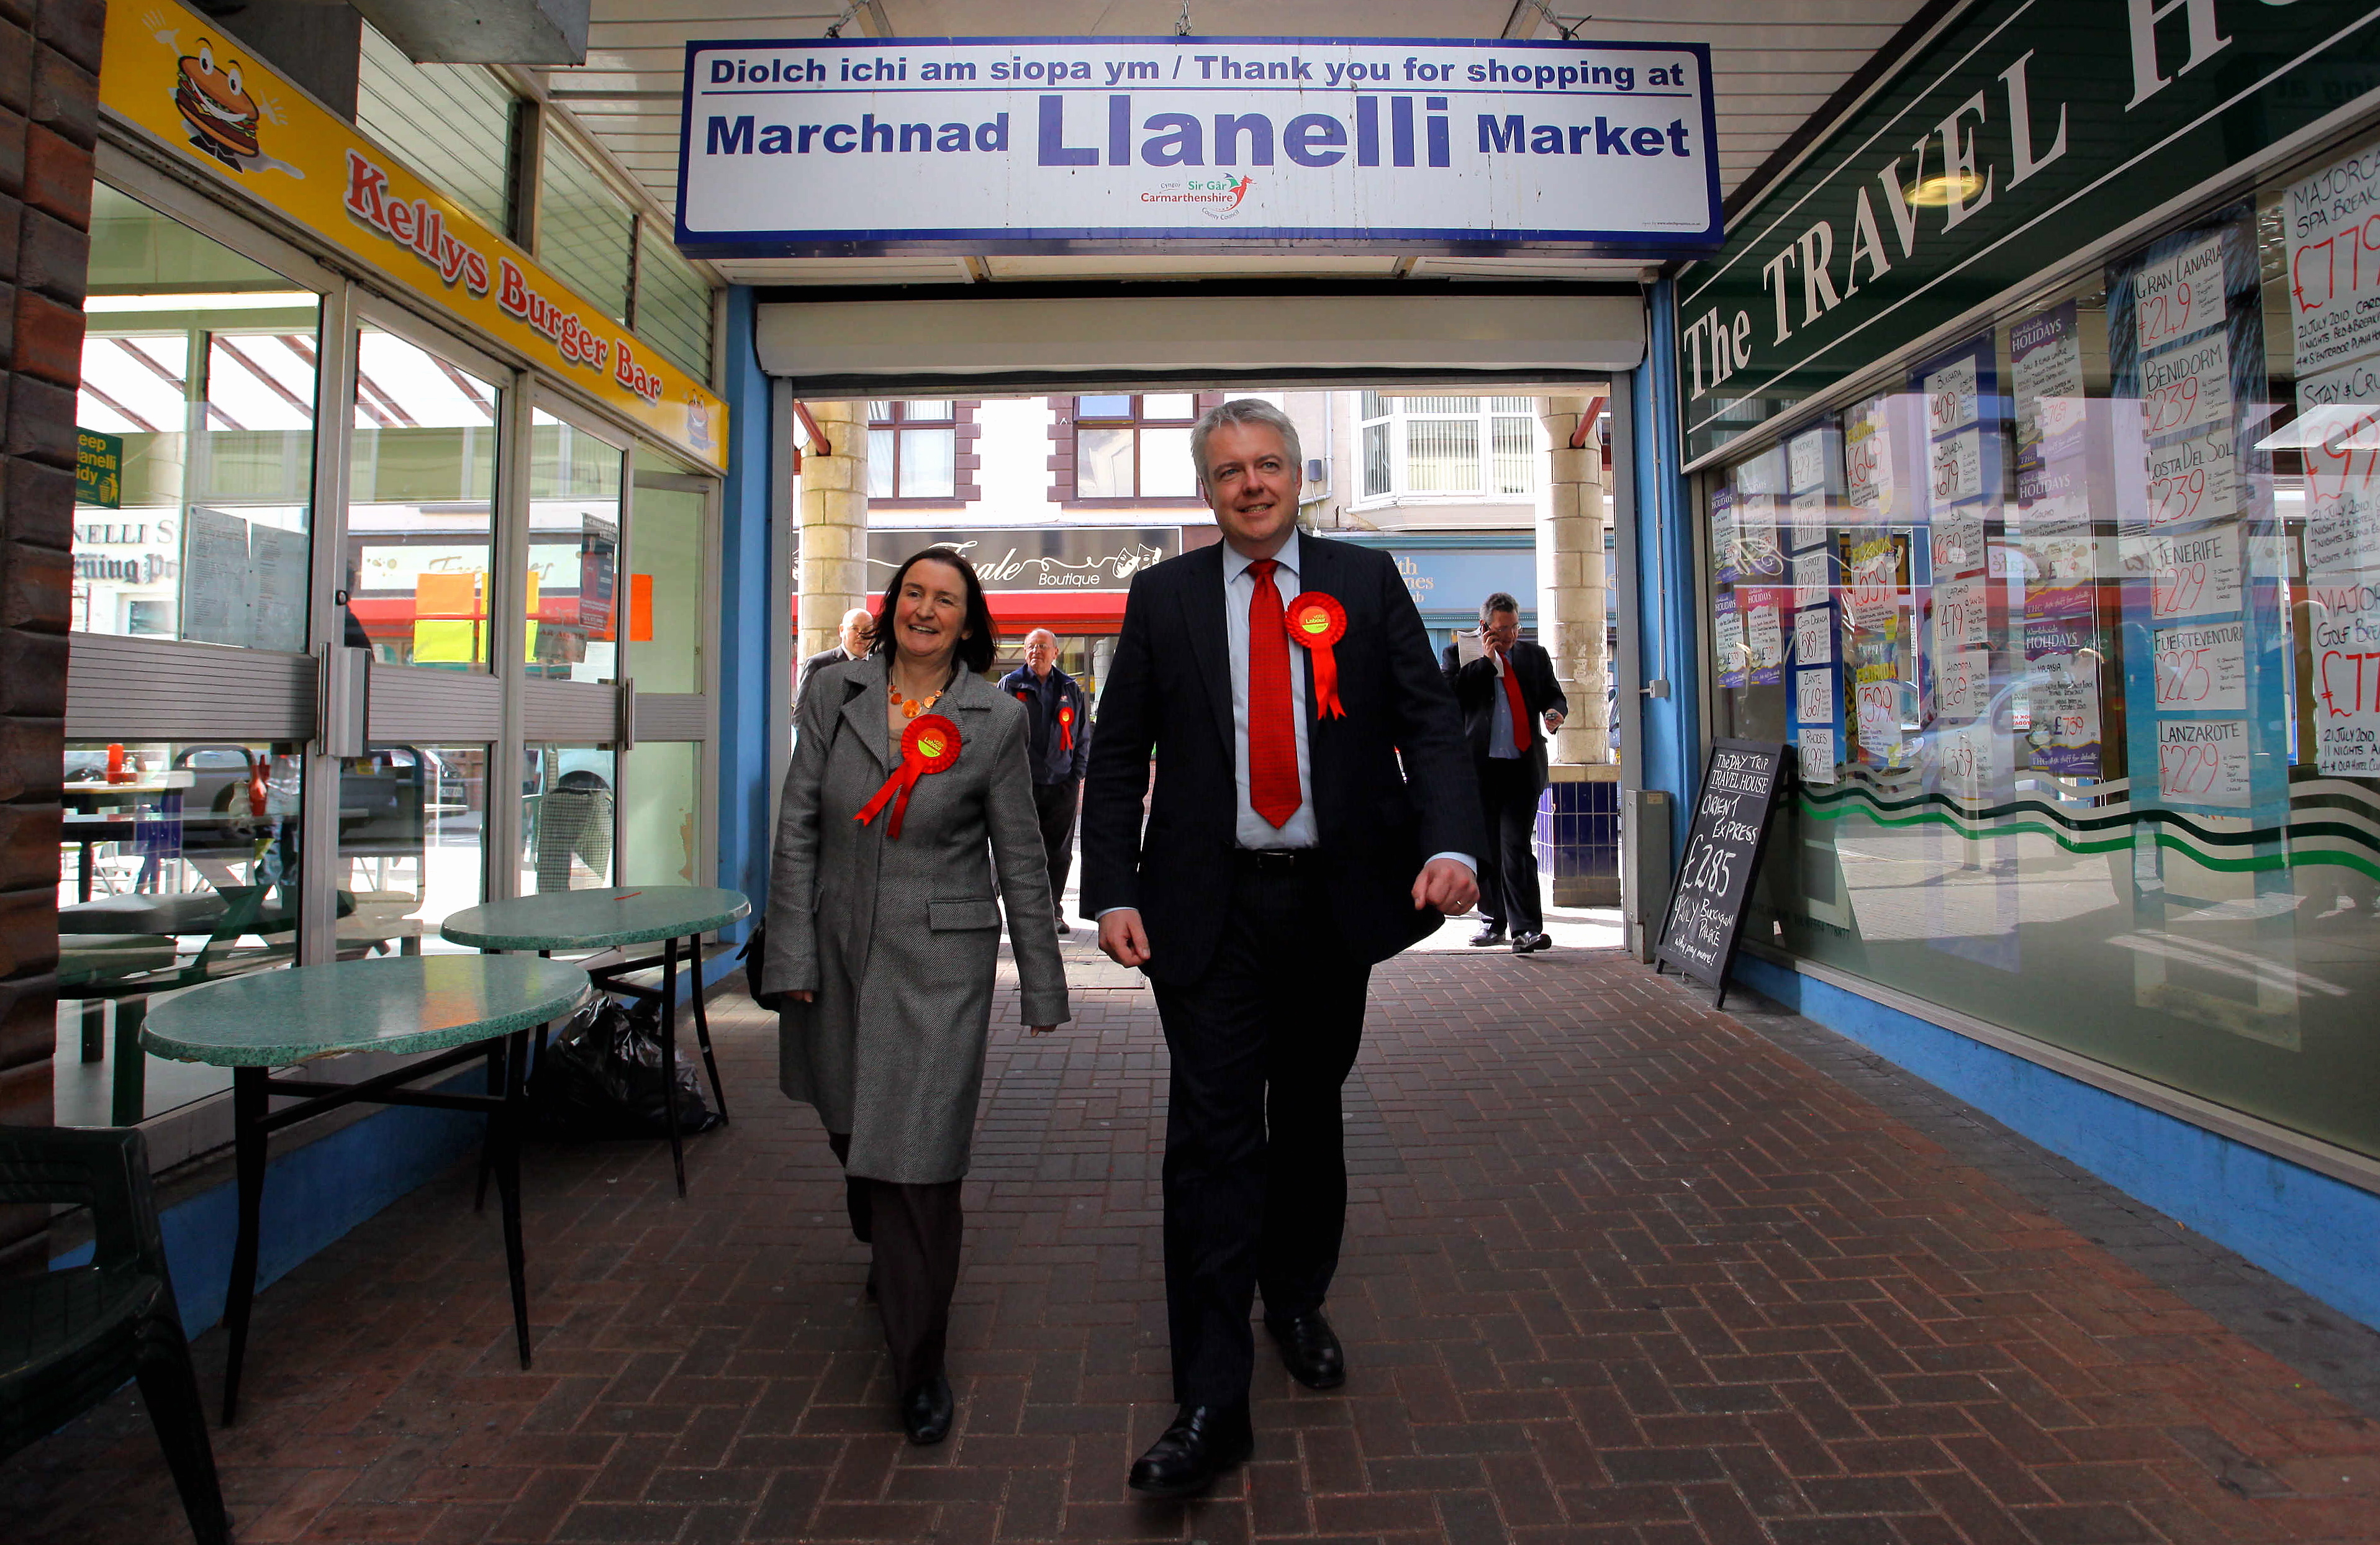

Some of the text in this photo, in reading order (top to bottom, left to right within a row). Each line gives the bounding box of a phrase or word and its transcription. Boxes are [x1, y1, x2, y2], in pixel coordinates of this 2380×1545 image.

[711, 55, 1684, 91] Diolch ichi am siopa ym / Thank you for shopping at
[707, 95, 1690, 167] Marchnad Llanelli Market
[1141, 193, 1233, 202] Carmarthenshire
[1188, 181, 1203, 190] Sir
[1207, 181, 1227, 190] Gâr
[1202, 207, 1239, 220] County Council
[1683, 48, 2066, 402] The TRAVEL
[2296, 209, 2328, 239] SPA
[346, 151, 663, 402] Kellys Burger Bar
[2135, 245, 2223, 300] GRAN CANARIA
[2138, 283, 2191, 347] £249
[2012, 319, 2061, 353] HOLIDAYS
[2145, 344, 2223, 392] BENIDORM
[2145, 376, 2198, 437] £239
[2304, 379, 2340, 410] STAY
[78, 433, 106, 452] eep
[2145, 432, 2234, 481] COSTA DEL SOL
[77, 446, 117, 470] lanelli
[76, 464, 98, 484] idy
[2019, 474, 2071, 499] HOLIDAYS
[2147, 469, 2205, 528] £239
[2152, 536, 2223, 568] TENERIFE
[1038, 573, 1100, 587] Boutique
[2152, 563, 2206, 616] £229
[1748, 591, 1771, 604] HOLIDAYS
[2026, 632, 2078, 650] HOLIDAYS
[2317, 621, 2351, 648] GOLF
[1803, 673, 1822, 686] ZANTE
[2154, 648, 2210, 704] £225
[1806, 730, 1827, 745] RHODES
[2159, 721, 2240, 743] LANZAROTE
[2334, 727, 2355, 743] JULY
[1717, 754, 1729, 769] The
[2160, 743, 2219, 797] £229
[1711, 769, 1768, 794] TRAVEL HOUSE
[1701, 794, 1740, 818] ORIENT
[1680, 833, 1737, 897] £285
